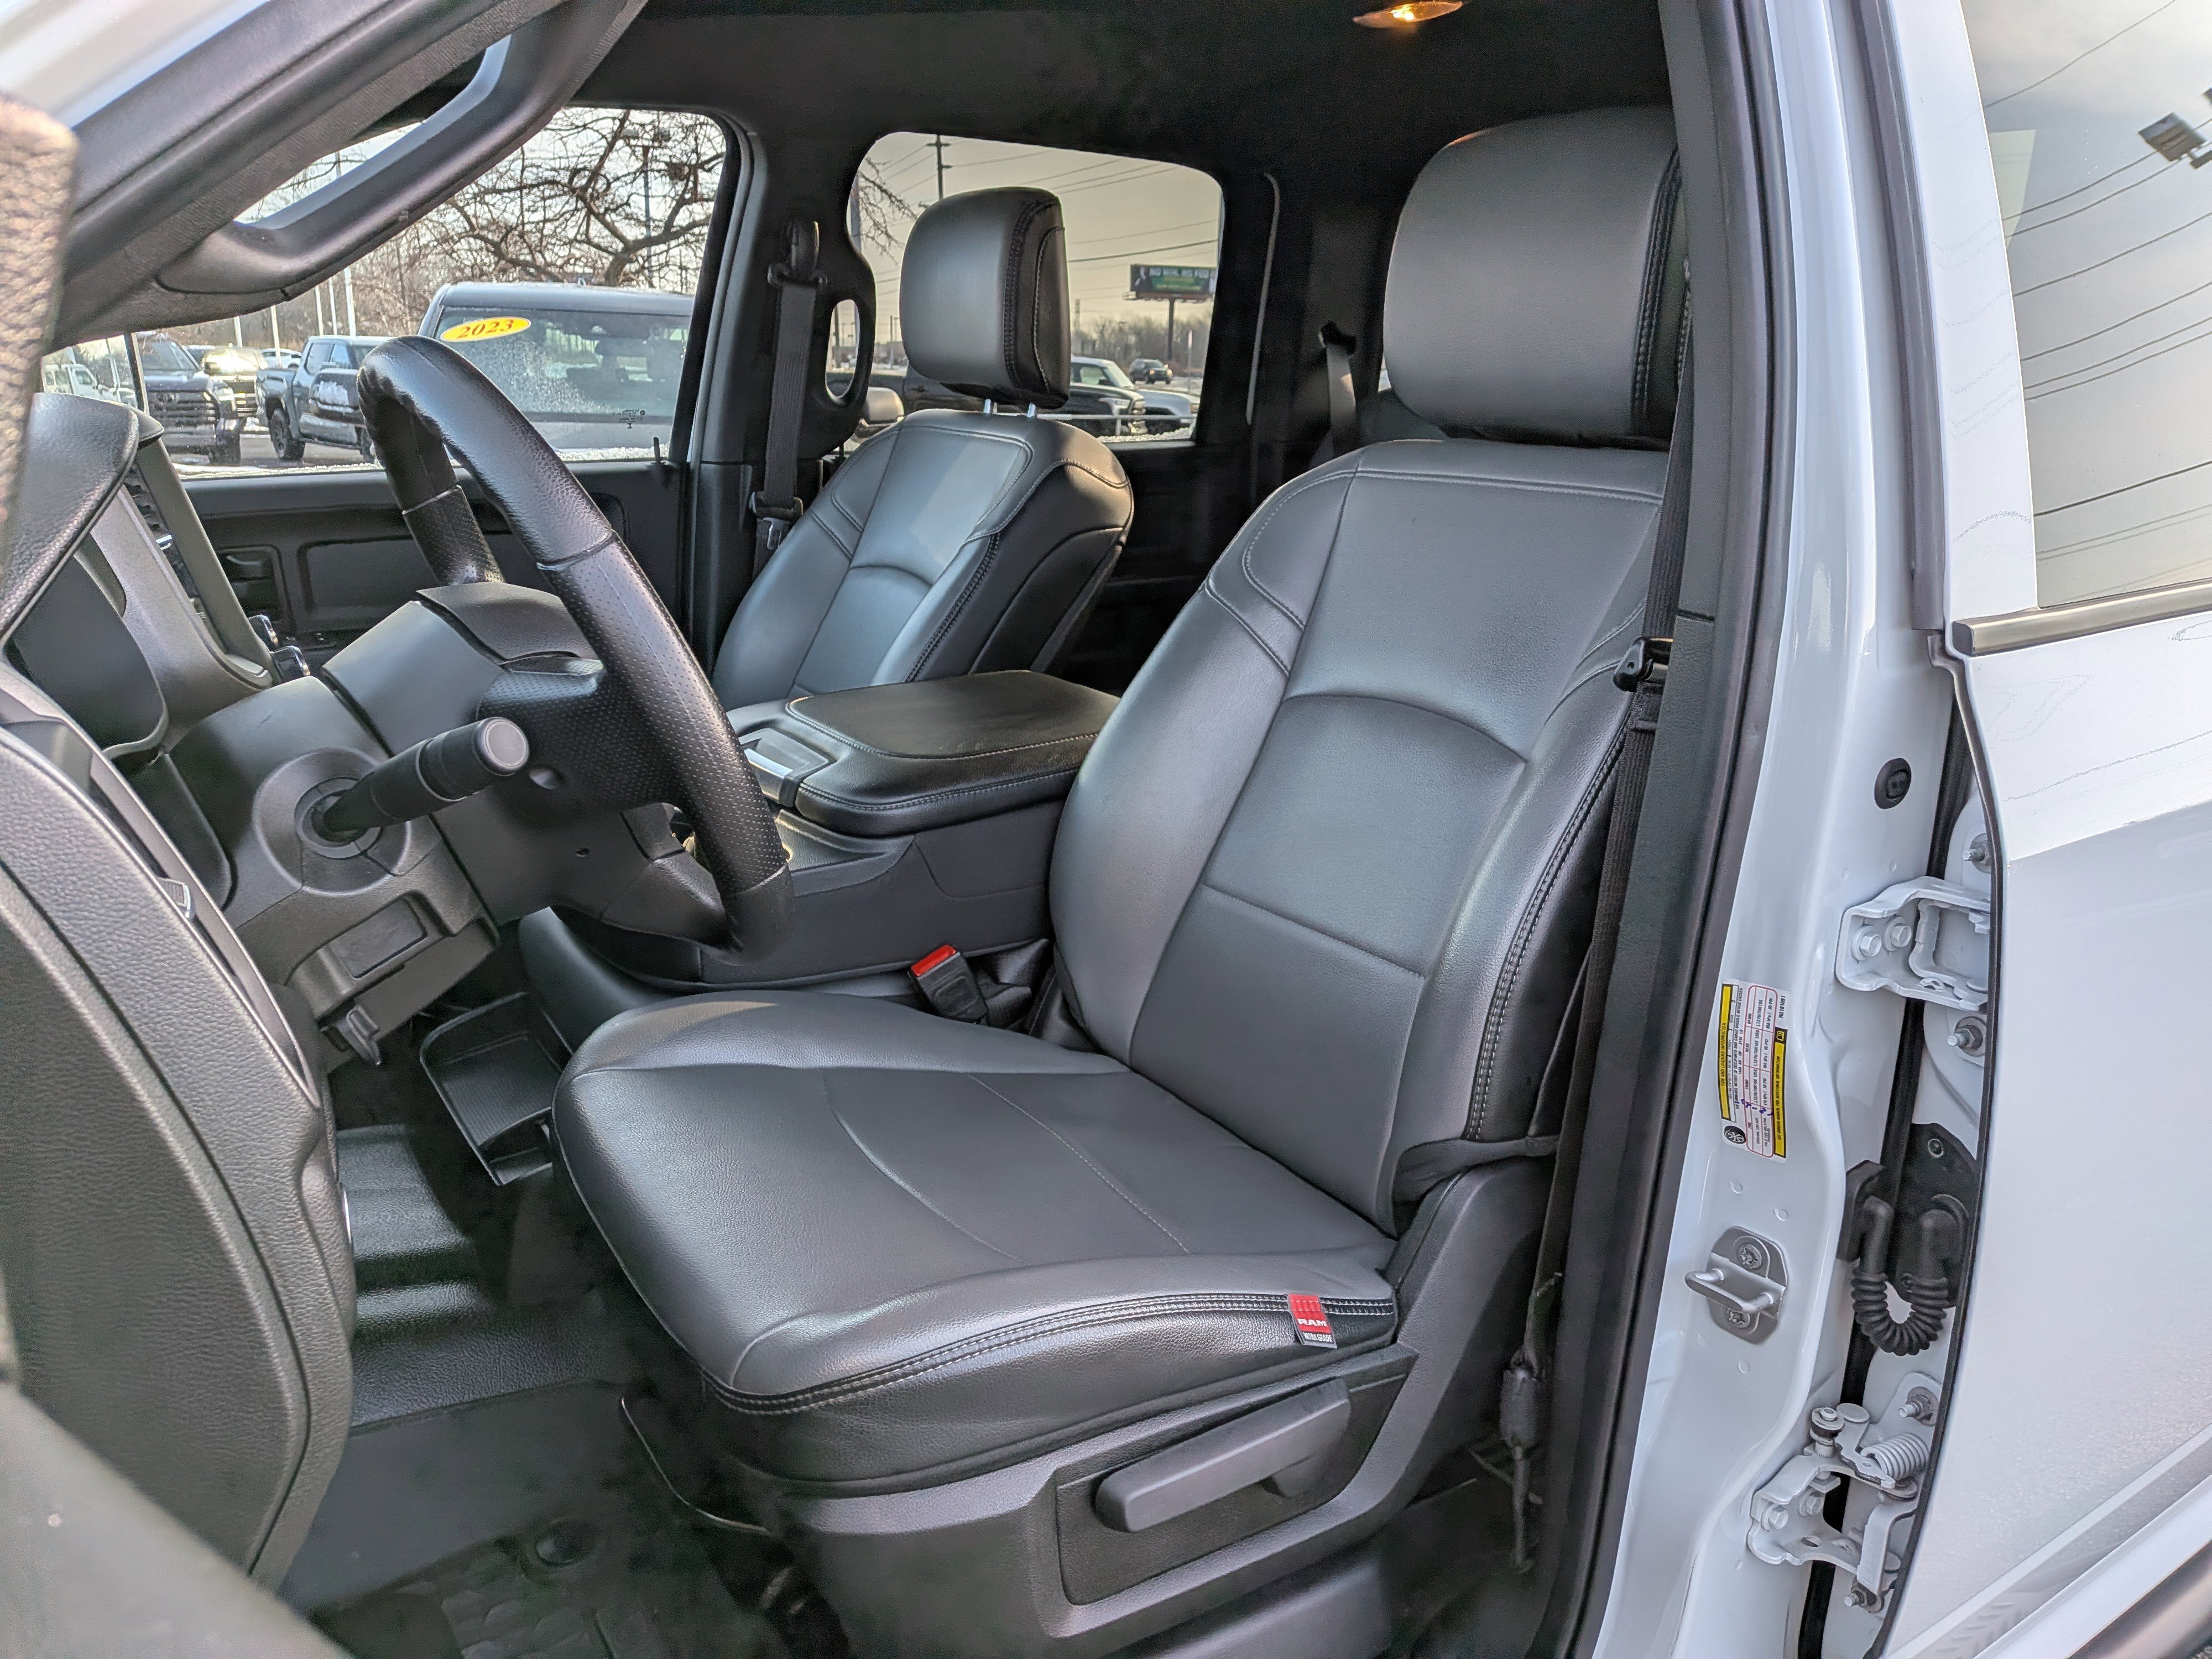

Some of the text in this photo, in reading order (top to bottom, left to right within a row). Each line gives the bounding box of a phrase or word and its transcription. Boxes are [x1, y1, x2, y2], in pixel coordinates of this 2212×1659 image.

[455, 319, 515, 340] 2023
[1297, 1318, 1327, 1327] RAM
[1303, 1332, 1332, 1342] WORK GRADE
